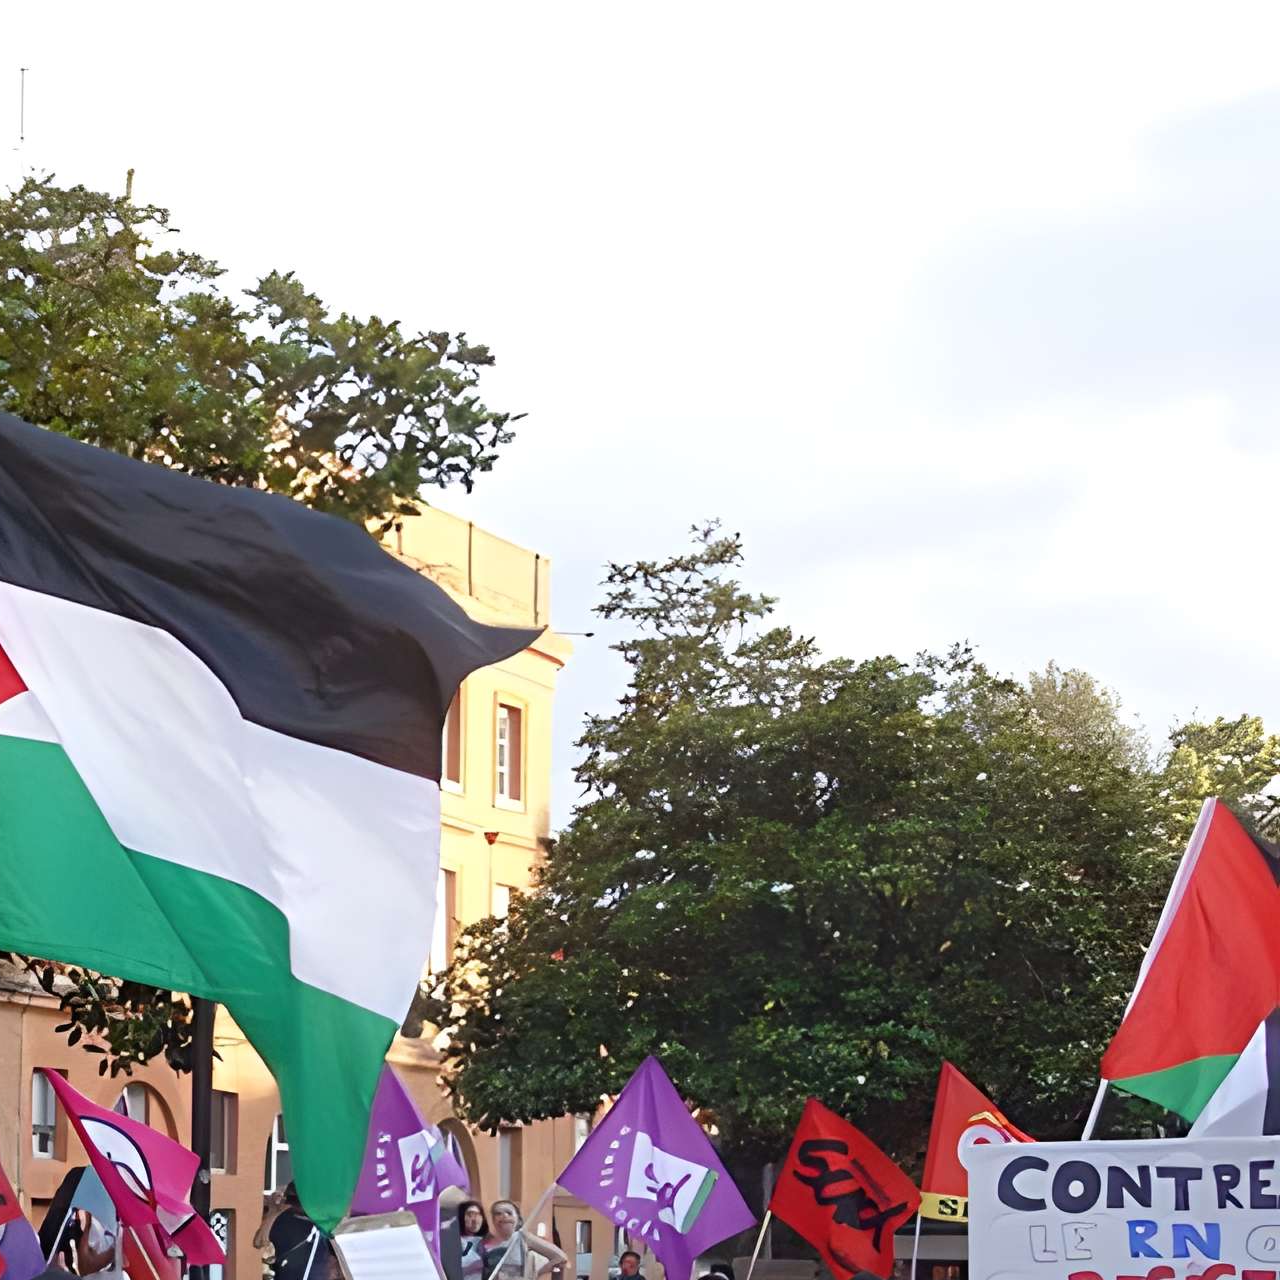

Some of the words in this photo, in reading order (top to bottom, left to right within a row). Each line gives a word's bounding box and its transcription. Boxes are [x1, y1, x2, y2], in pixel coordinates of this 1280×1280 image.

[997, 1155, 1278, 1214] CONTRE
[1029, 1221, 1098, 1263] LE
[1126, 1219, 1221, 1261] RN
